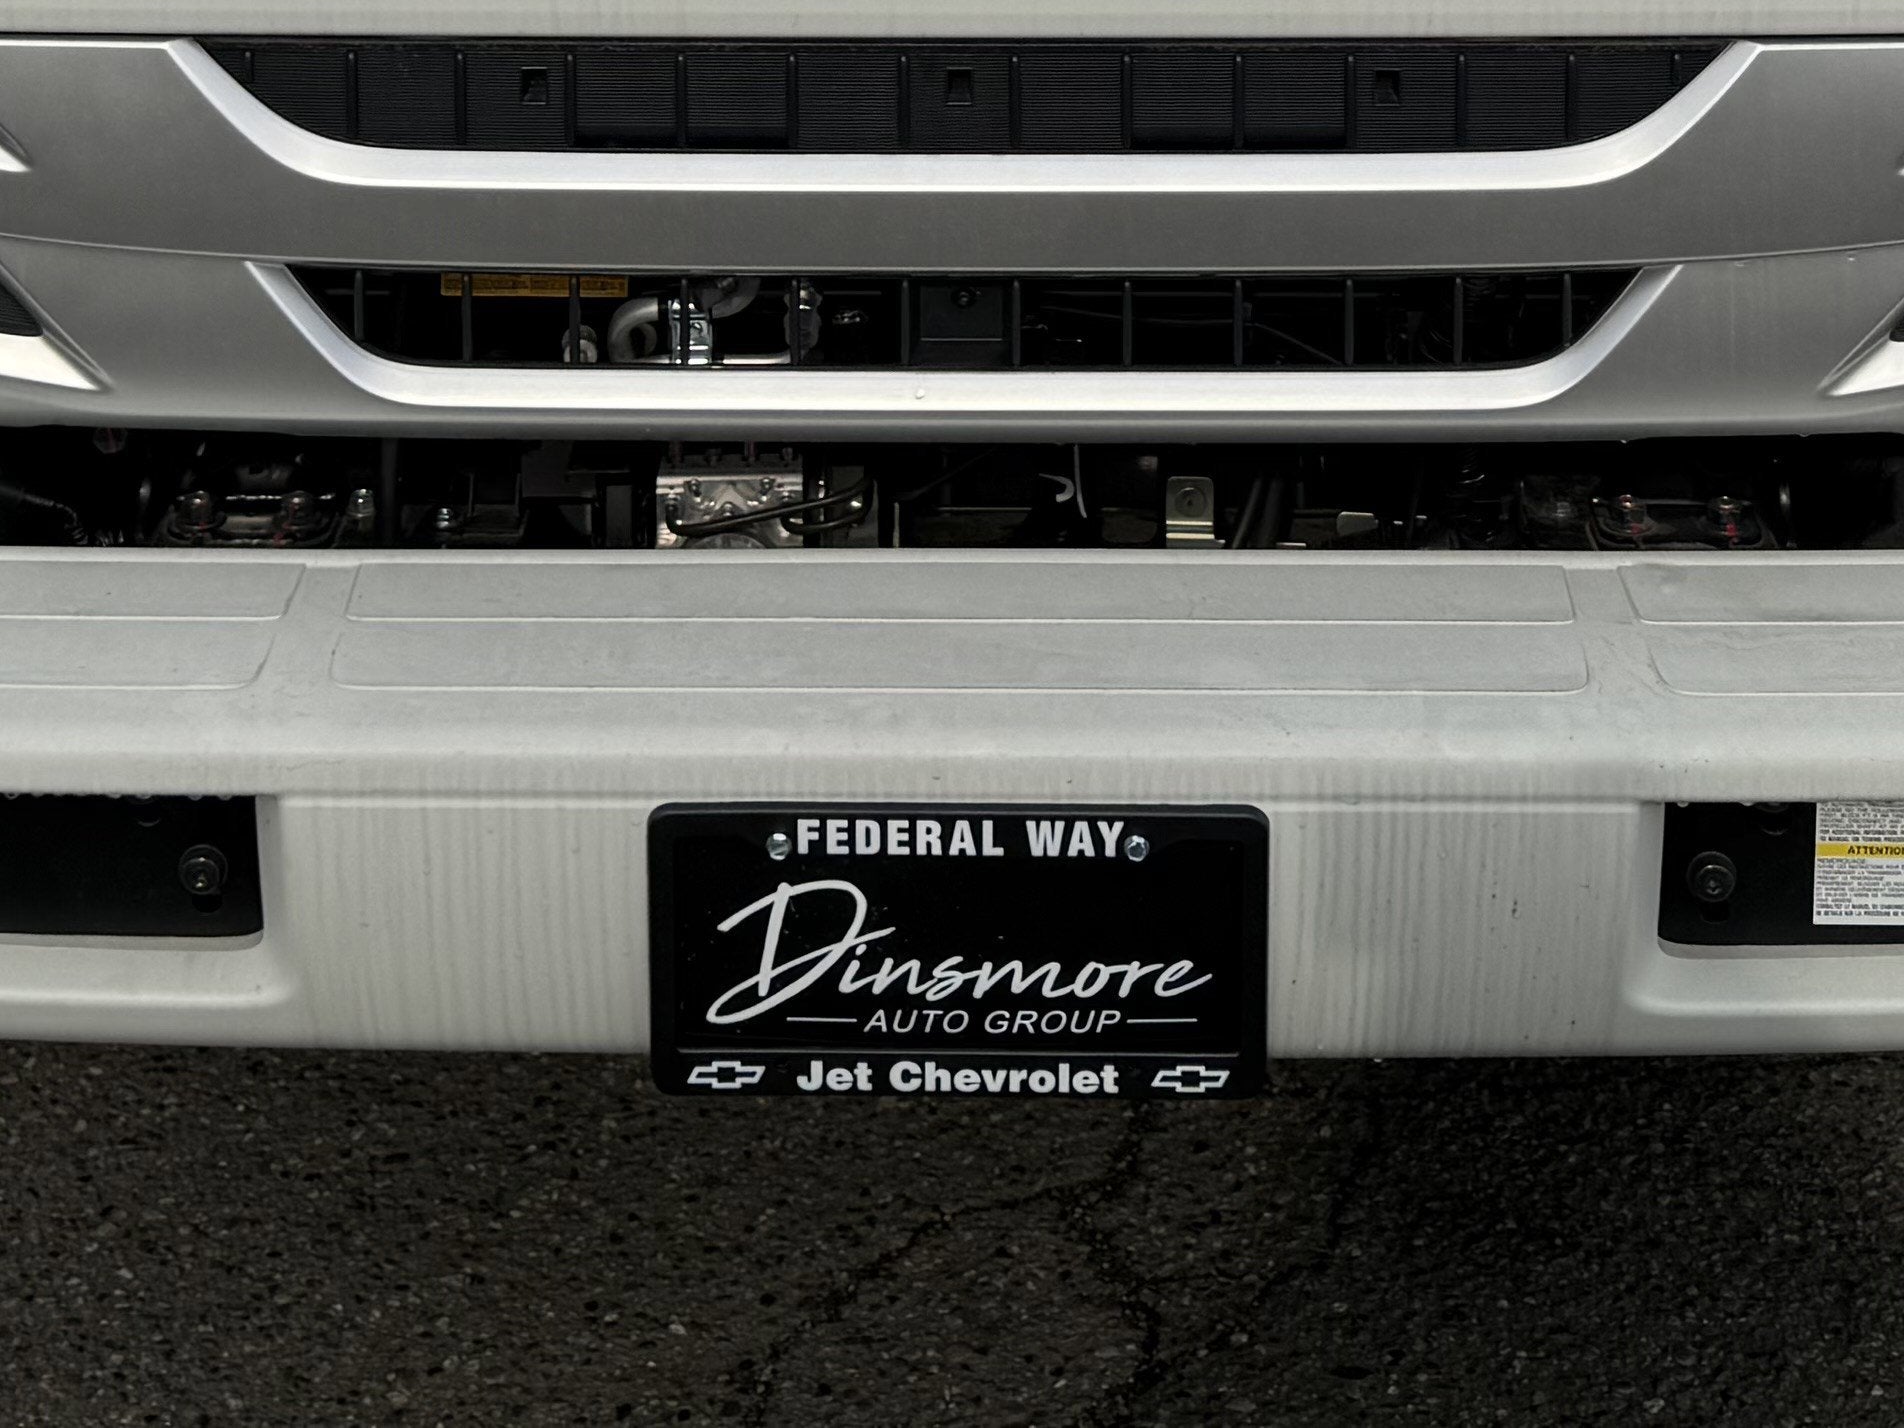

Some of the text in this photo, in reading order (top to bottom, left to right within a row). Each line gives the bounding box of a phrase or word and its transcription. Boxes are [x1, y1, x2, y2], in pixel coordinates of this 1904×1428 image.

[797, 818, 1125, 858] FEDERAL WAY
[705, 878, 1214, 1026] Dinsmore
[863, 1009, 1122, 1035] AUTO GROUP
[796, 1060, 1120, 1095] Jet Chevrolet
